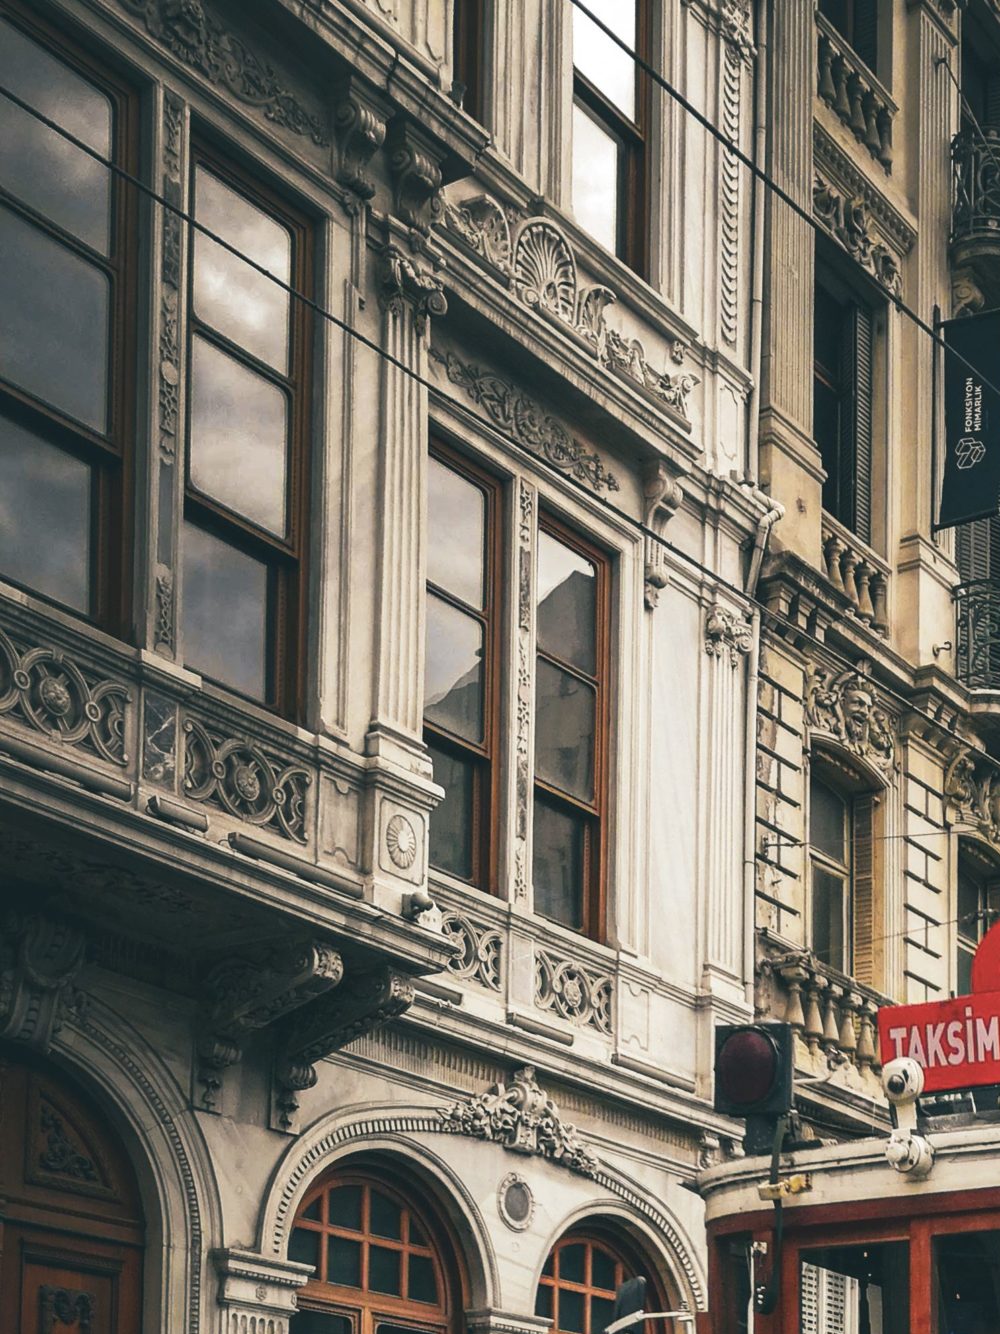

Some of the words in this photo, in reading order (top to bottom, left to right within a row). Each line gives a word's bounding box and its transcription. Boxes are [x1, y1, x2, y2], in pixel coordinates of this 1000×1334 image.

[964, 377, 974, 432] FONKSİYON
[974, 385, 982, 431] MİMARLIK
[889, 1006, 1000, 1069] TAKSİM
